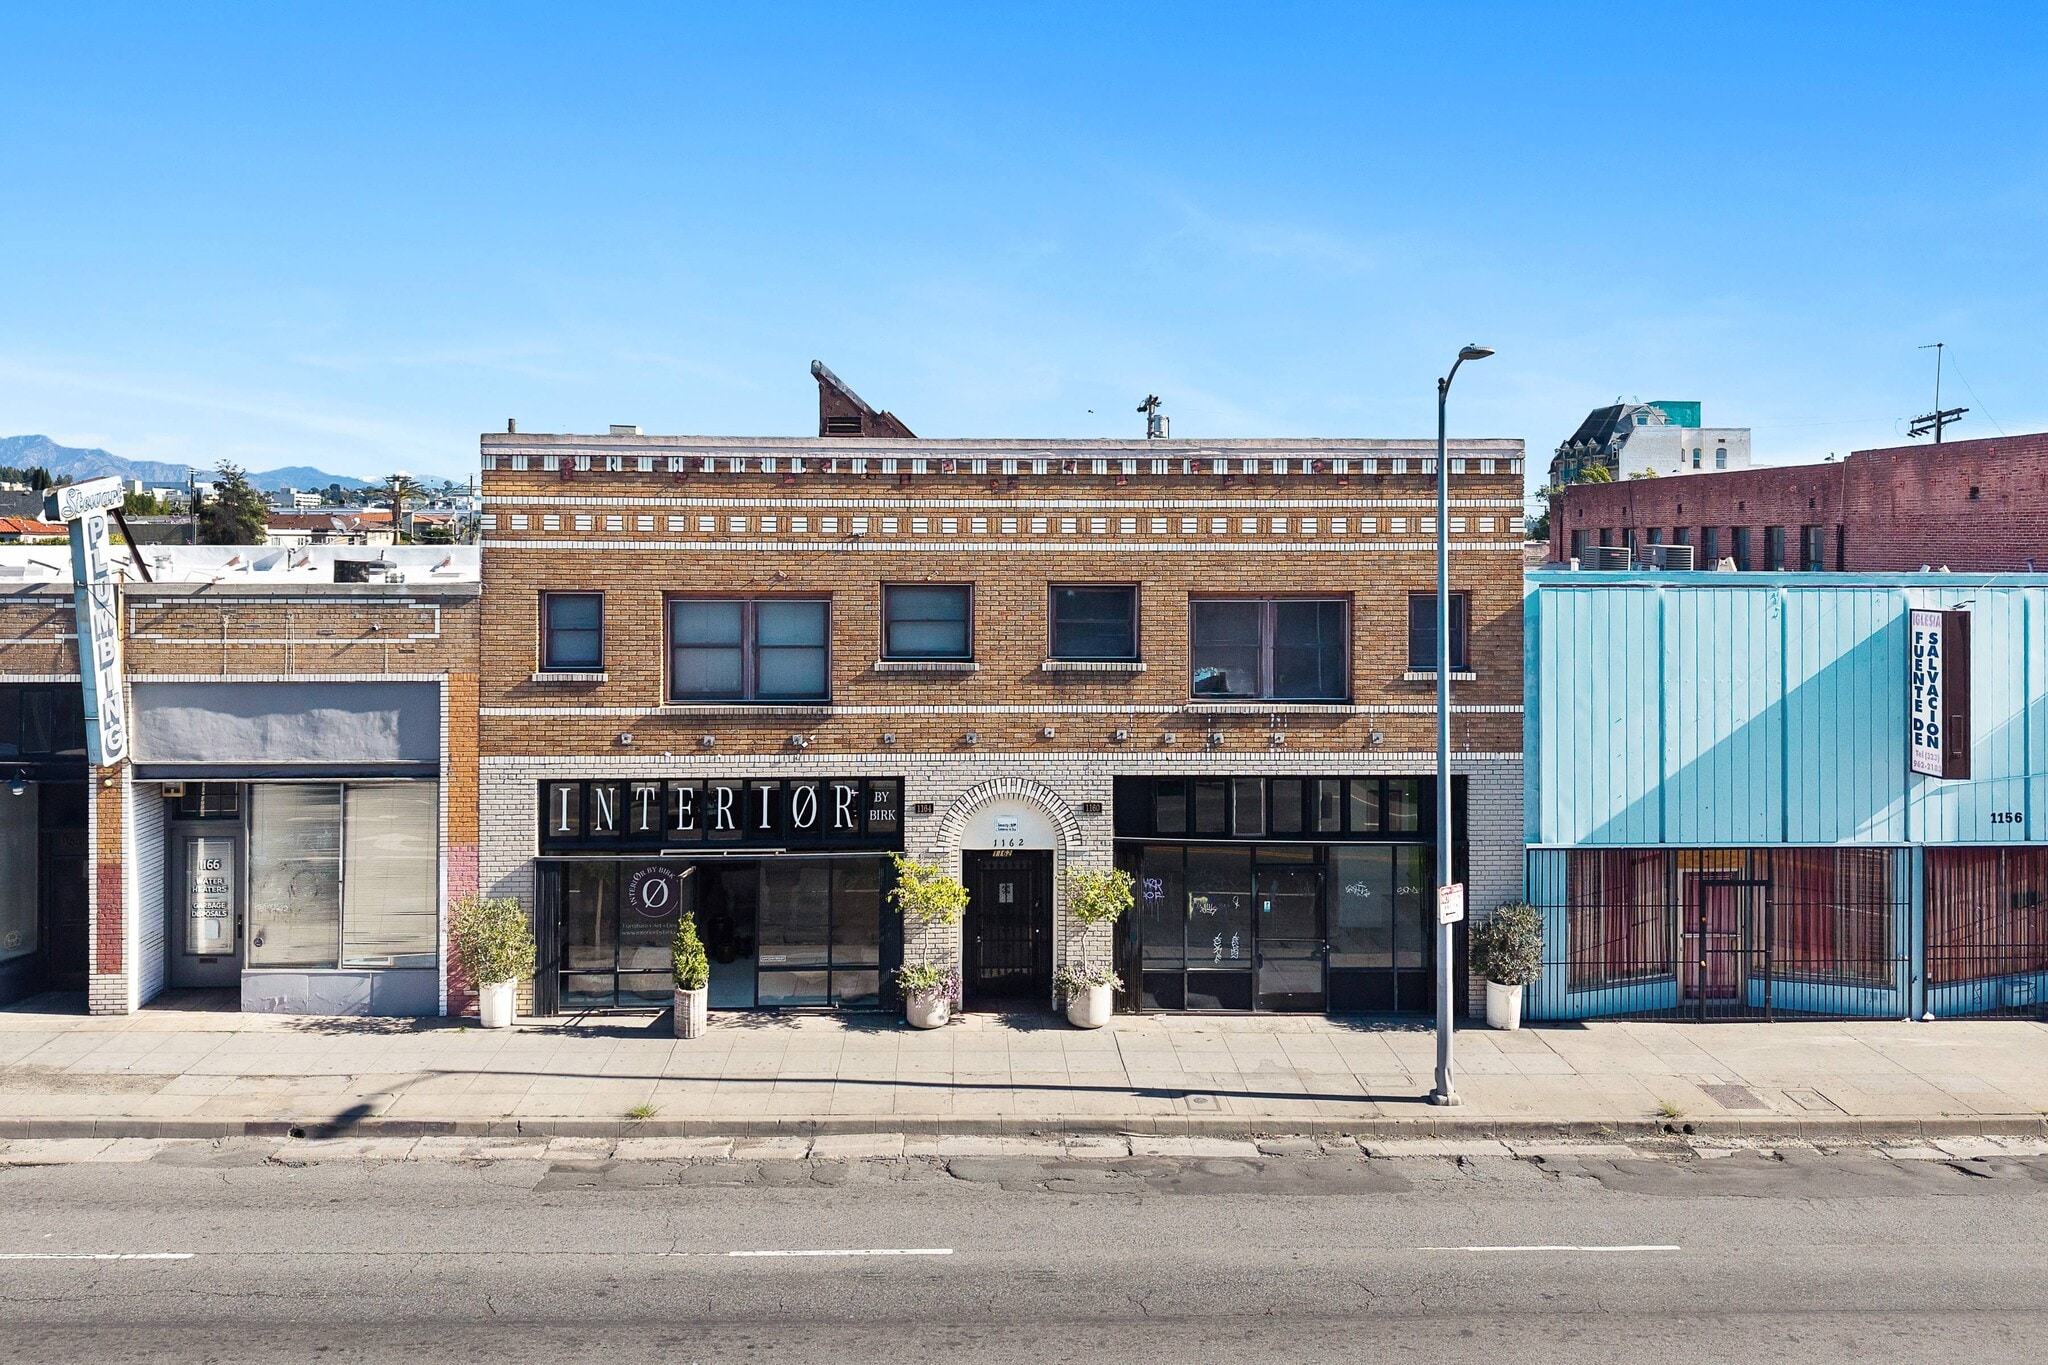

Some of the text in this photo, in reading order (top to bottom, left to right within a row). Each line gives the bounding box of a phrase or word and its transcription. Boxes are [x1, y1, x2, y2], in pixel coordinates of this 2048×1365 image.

[61, 485, 124, 518] Stewart
[1912, 613, 1942, 627] IGLESIA
[88, 516, 123, 758] PLUMBING
[1913, 631, 1925, 746] FUENTE DE
[1926, 632, 1939, 749] SALVACION
[874, 791, 890, 803] BY
[917, 804, 932, 813] 1164
[869, 809, 896, 821] BIRK
[1990, 812, 2023, 824] 1156
[993, 838, 1024, 847] 1162
[199, 859, 220, 871] 1166
[196, 877, 224, 886] WATER
[192, 885, 228, 894] HEATERS
[193, 902, 227, 910] GARBAGE
